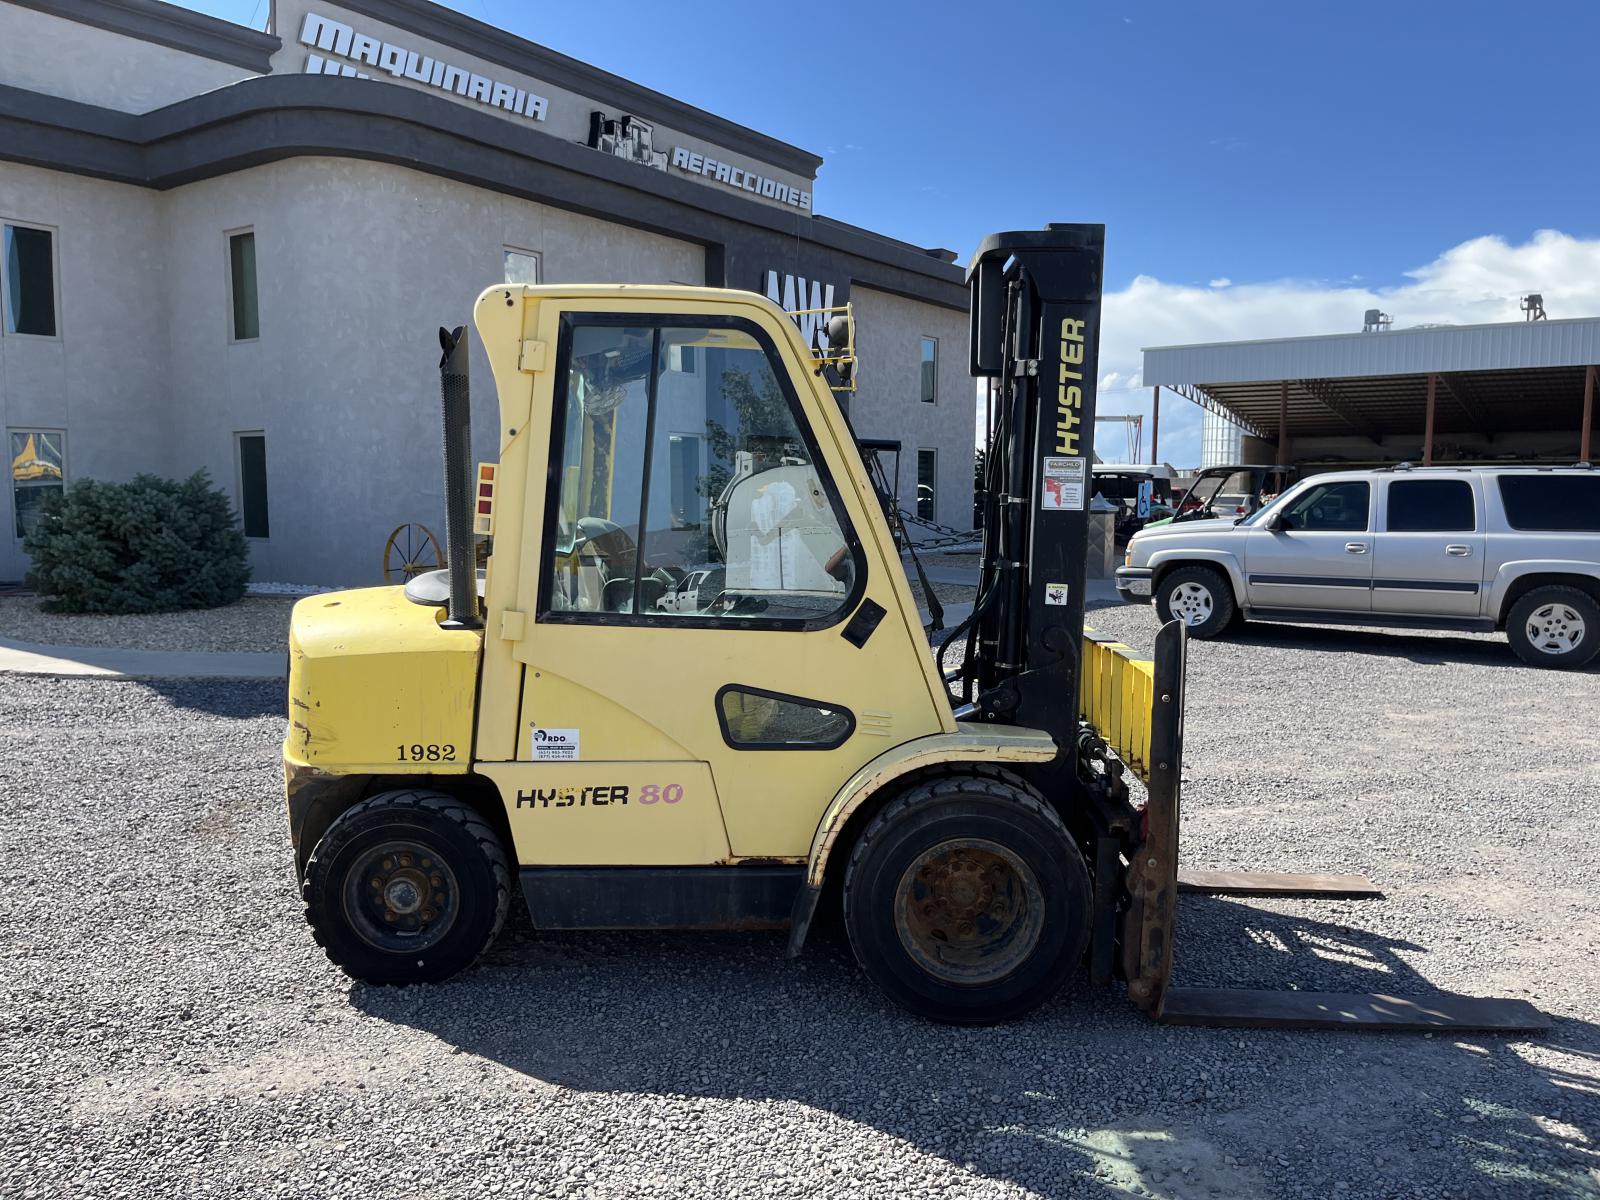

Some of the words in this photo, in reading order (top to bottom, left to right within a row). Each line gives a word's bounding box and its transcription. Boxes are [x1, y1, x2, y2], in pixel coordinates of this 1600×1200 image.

[299, 13, 549, 122] MAQUINARIA
[672, 146, 812, 210] REFACCIONES
[1055, 317, 1085, 456] HYSTER
[396, 744, 457, 761] 1982
[516, 785, 629, 808] HYSTER
[638, 783, 684, 804] 80
